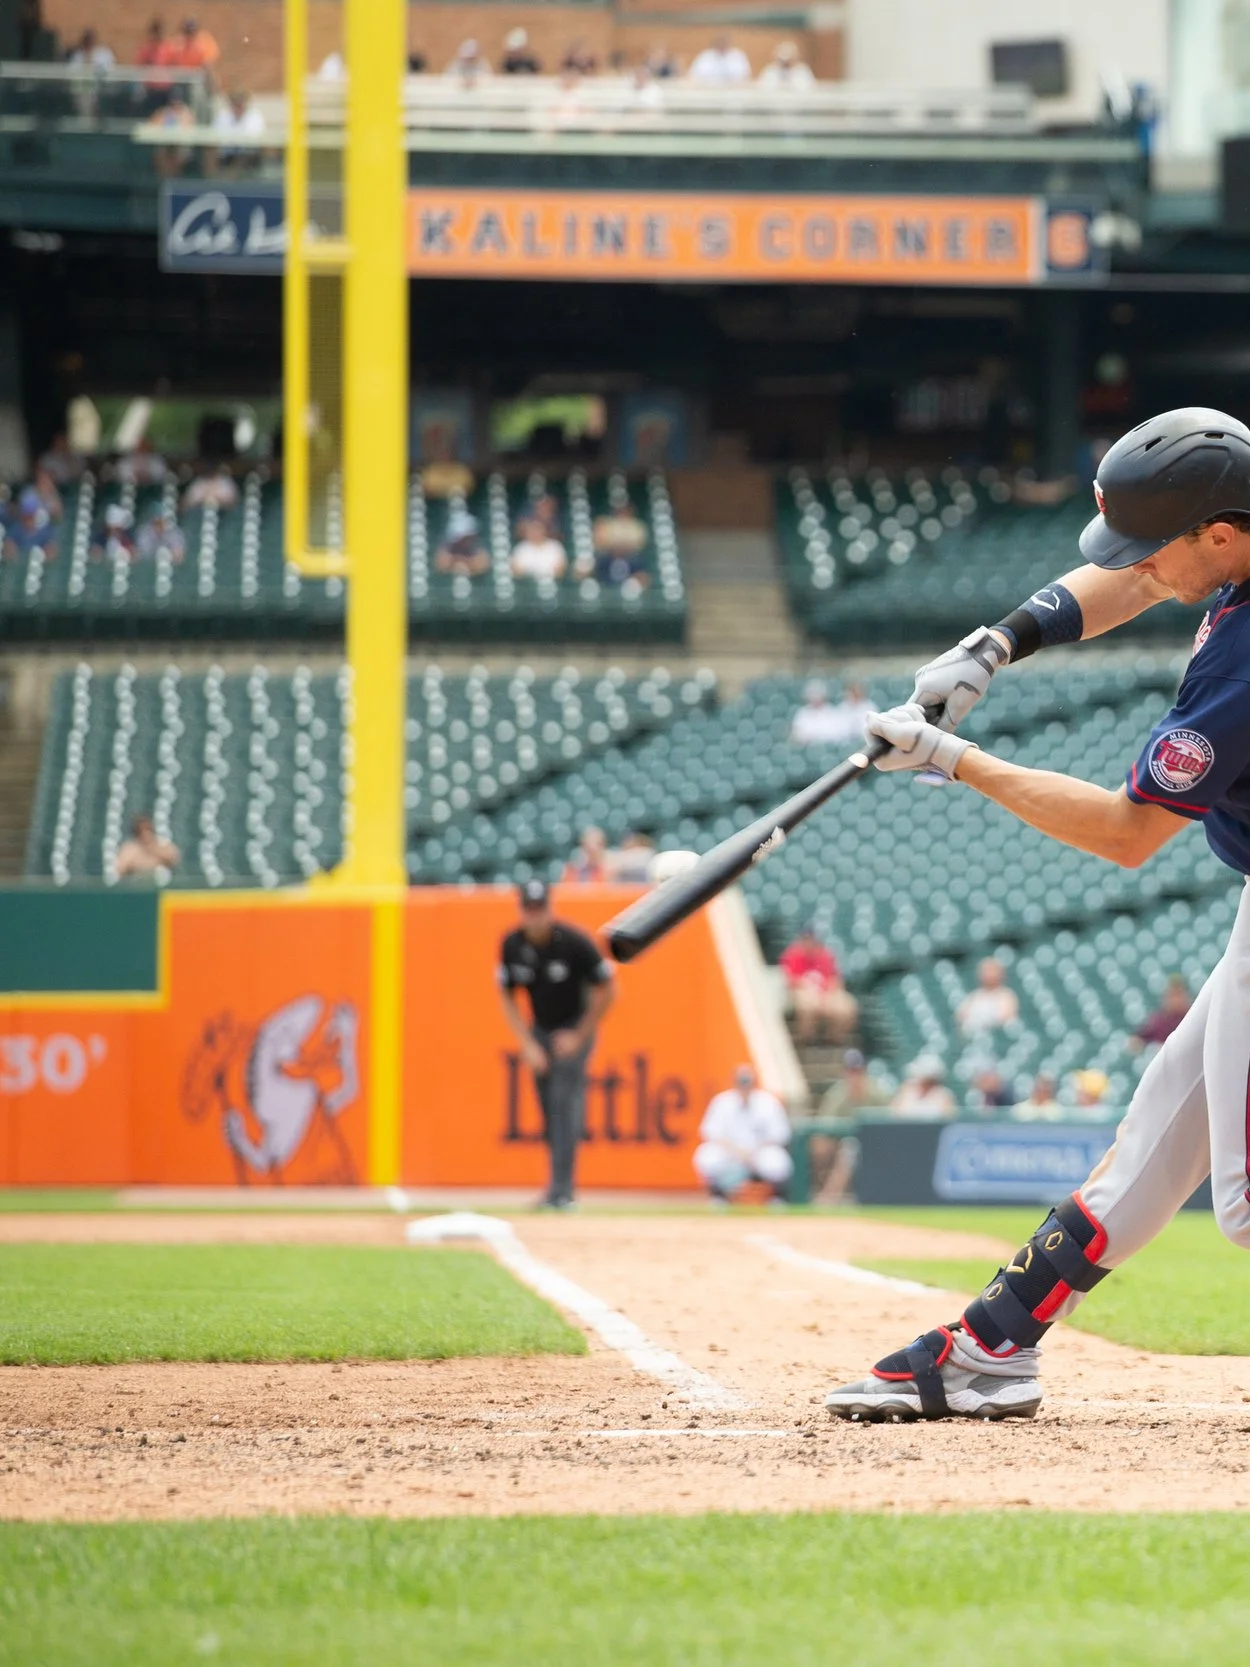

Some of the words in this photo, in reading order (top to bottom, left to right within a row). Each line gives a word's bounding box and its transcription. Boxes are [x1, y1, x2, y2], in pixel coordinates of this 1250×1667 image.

[760, 211, 1018, 263] CORNER
[1169, 732, 1212, 762] MINNESOTA
[503, 1051, 690, 1145] Ltle
